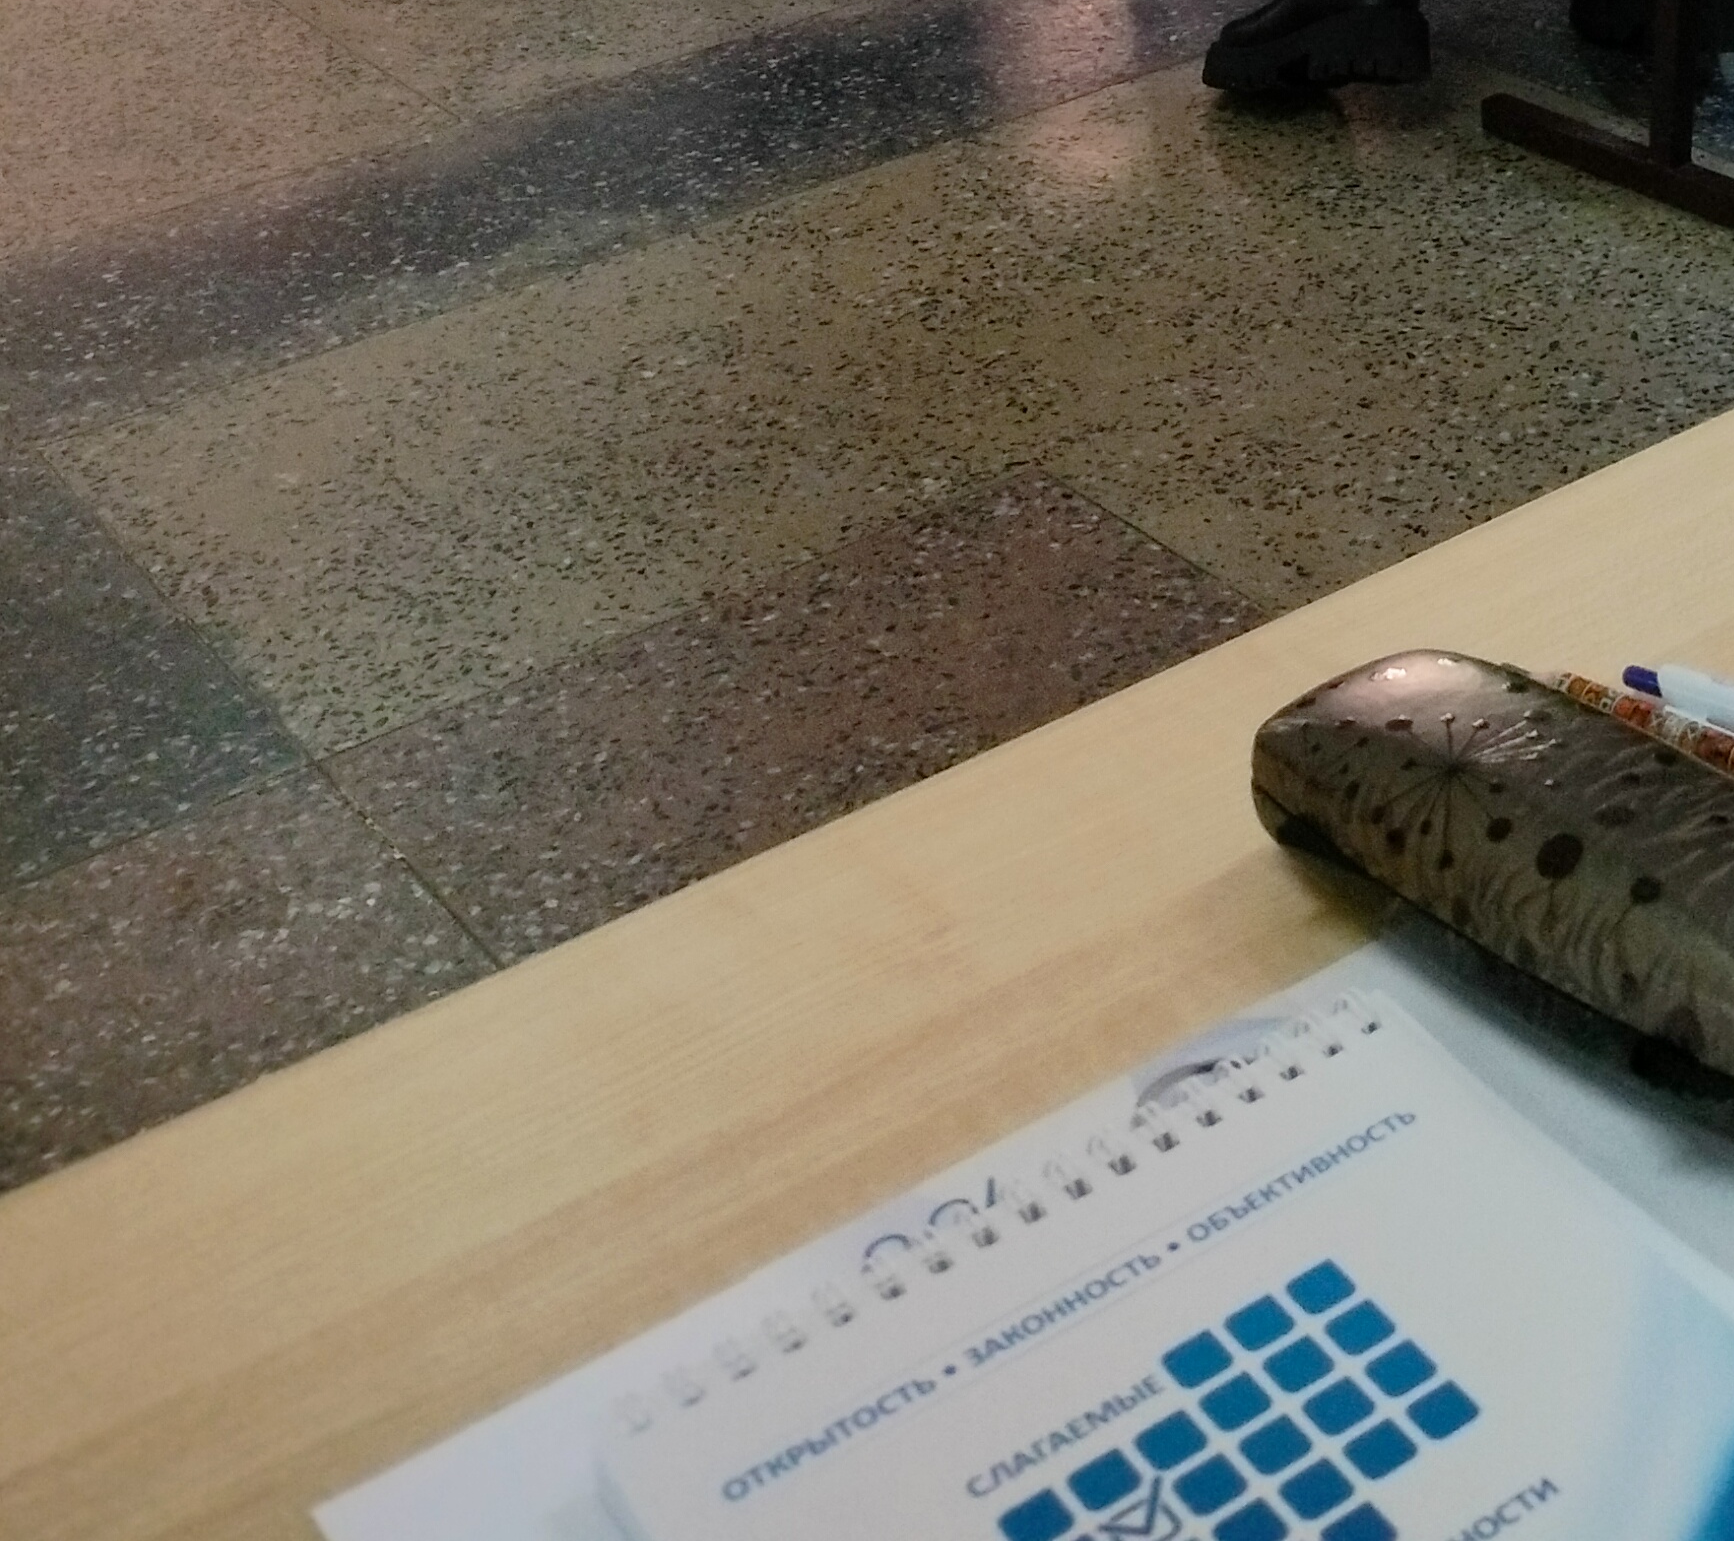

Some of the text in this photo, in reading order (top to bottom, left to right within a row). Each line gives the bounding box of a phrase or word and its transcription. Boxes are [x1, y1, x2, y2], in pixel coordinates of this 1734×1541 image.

[720, 1106, 1418, 1505] ОТКРЫТОСТЬ ЗАКОННОСТЬ ОБЪЕКТИВНОСТЬ
[965, 1374, 1167, 1499] СЛАГАЕМЫЕ
